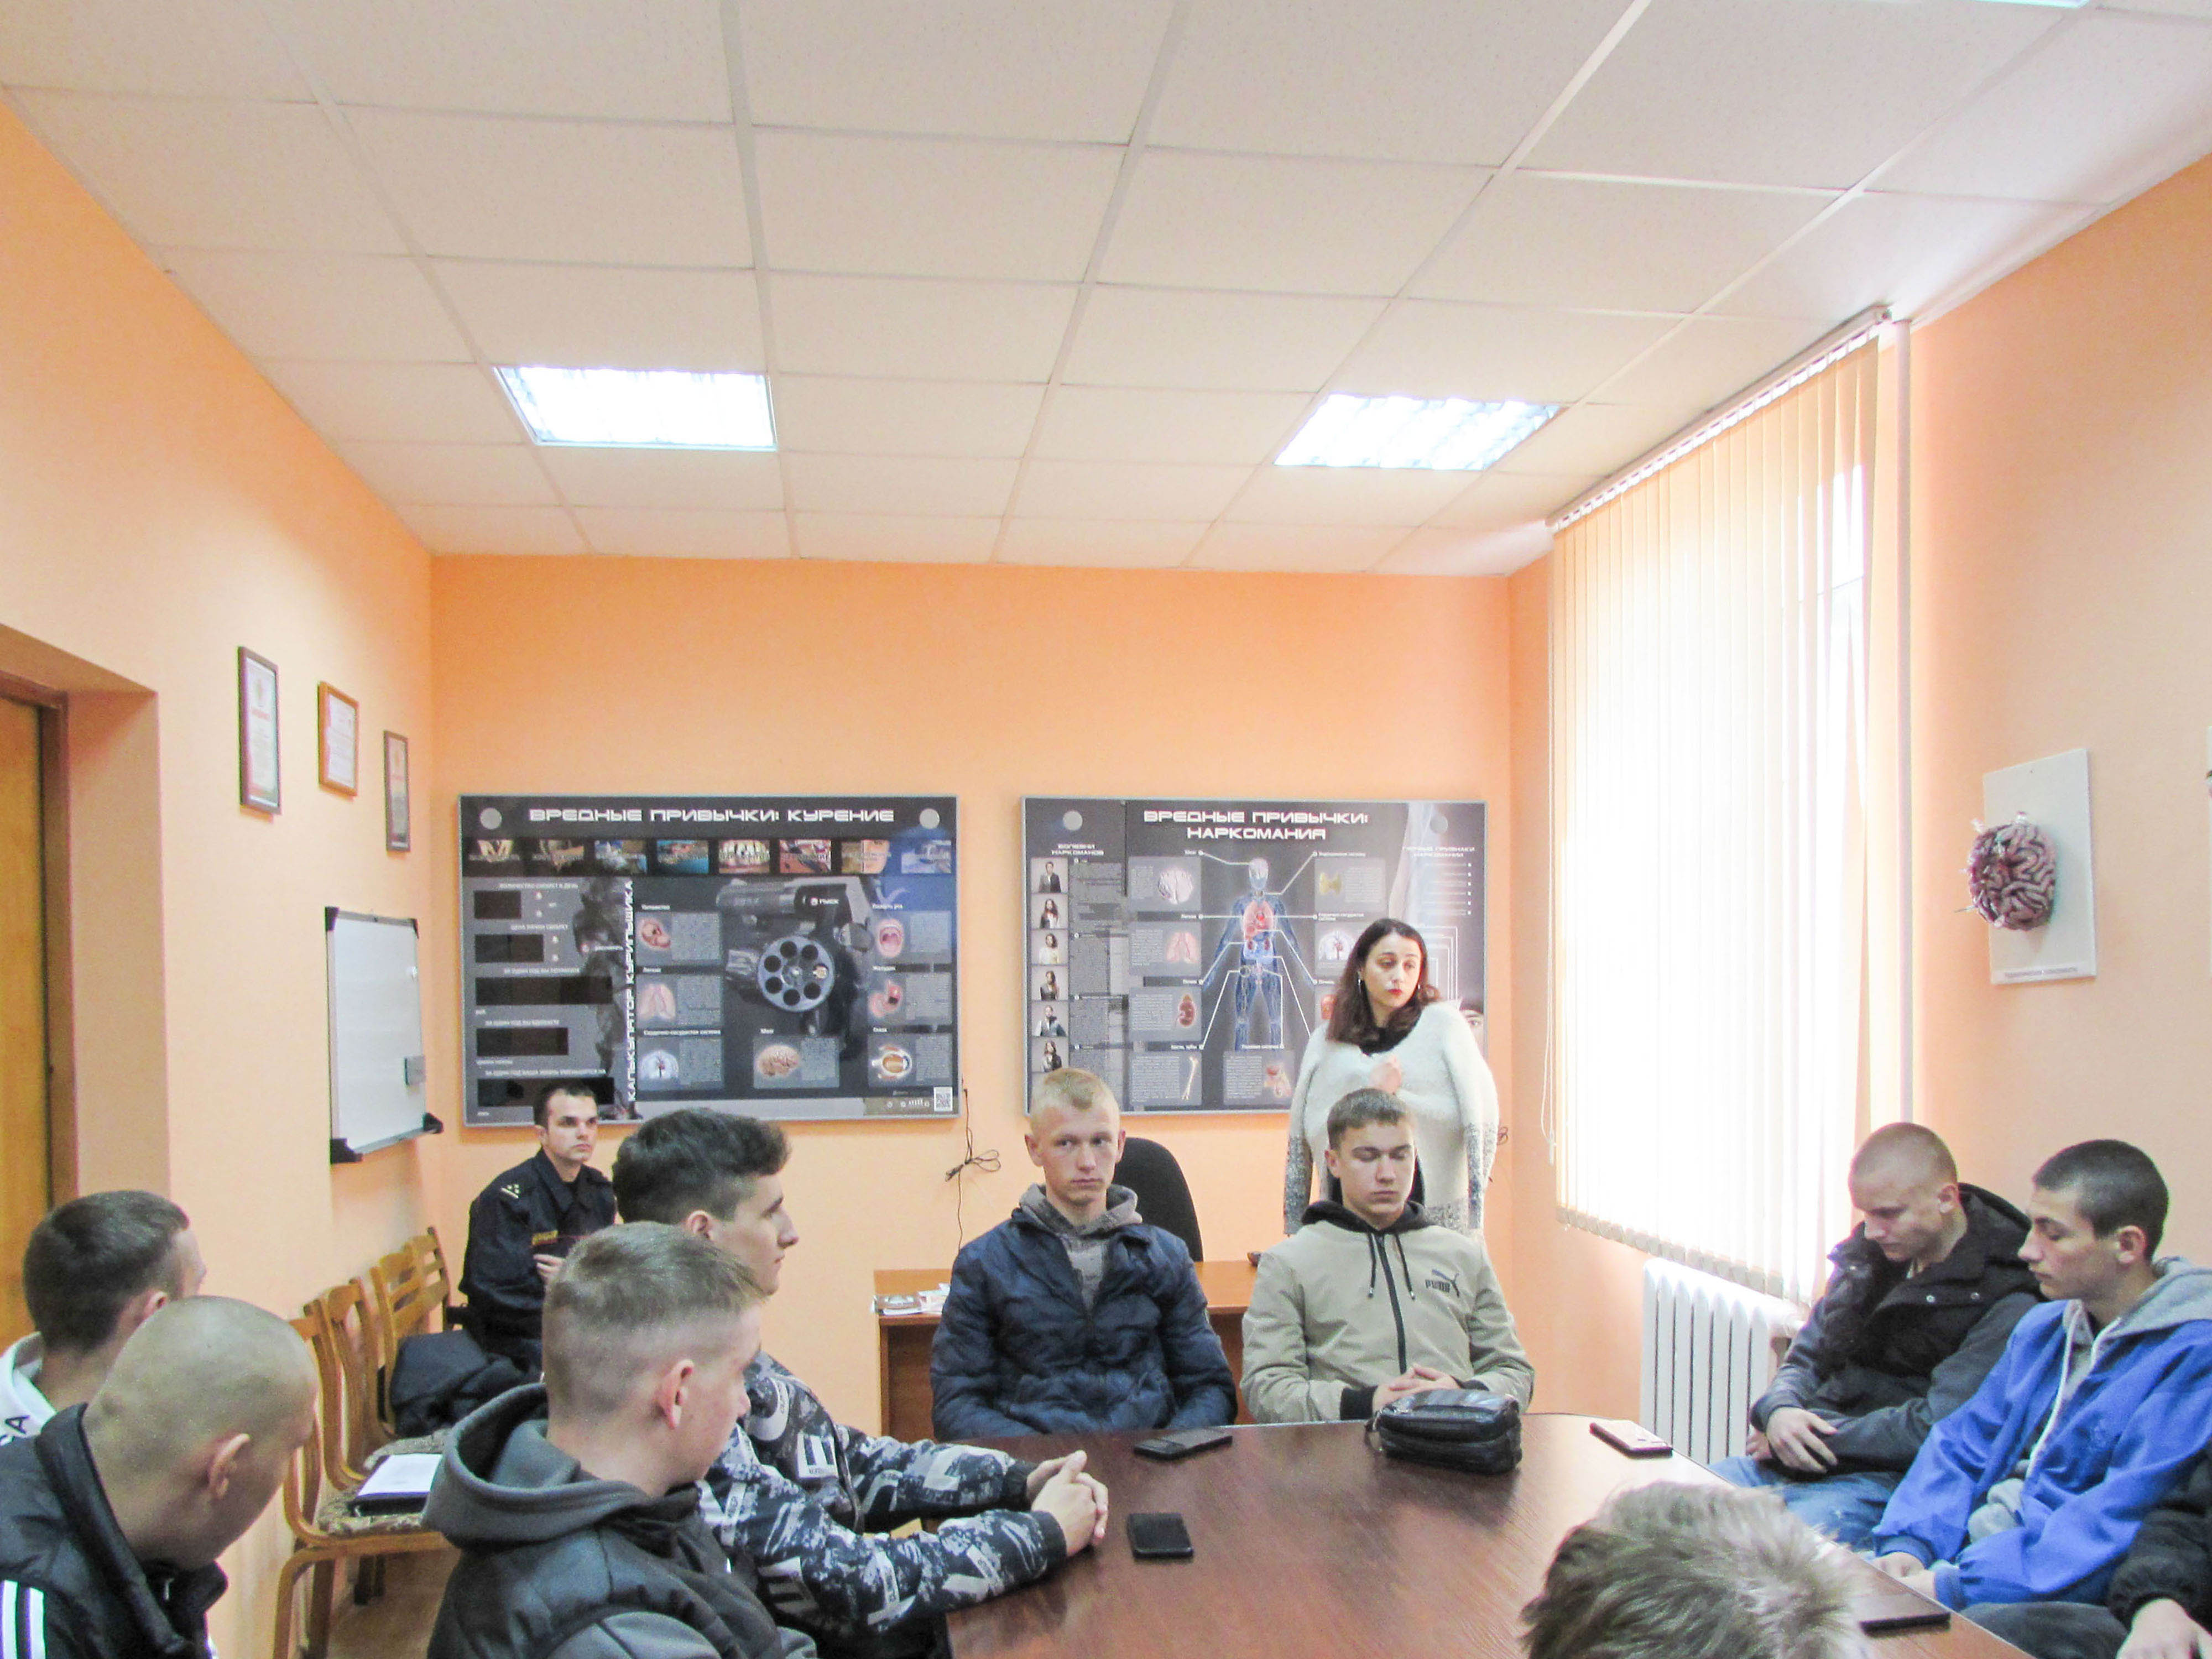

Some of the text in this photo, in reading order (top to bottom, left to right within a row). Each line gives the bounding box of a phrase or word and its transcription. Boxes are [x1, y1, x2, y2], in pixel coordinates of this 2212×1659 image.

[529, 809, 894, 822] ВРЕДНЫЕ ПРИВЫЧКИ: КУРЕНИЕ
[1144, 811, 1369, 824] ВРЕДНЫЕ ПРИВЫЧКИ:
[1187, 827, 1326, 840] НАРКОМАНИЯ
[624, 880, 637, 1102] КАЛЬКУЛЯТОР КУРИЛЬЩИКА
[1425, 1279, 1451, 1293] PUMA
